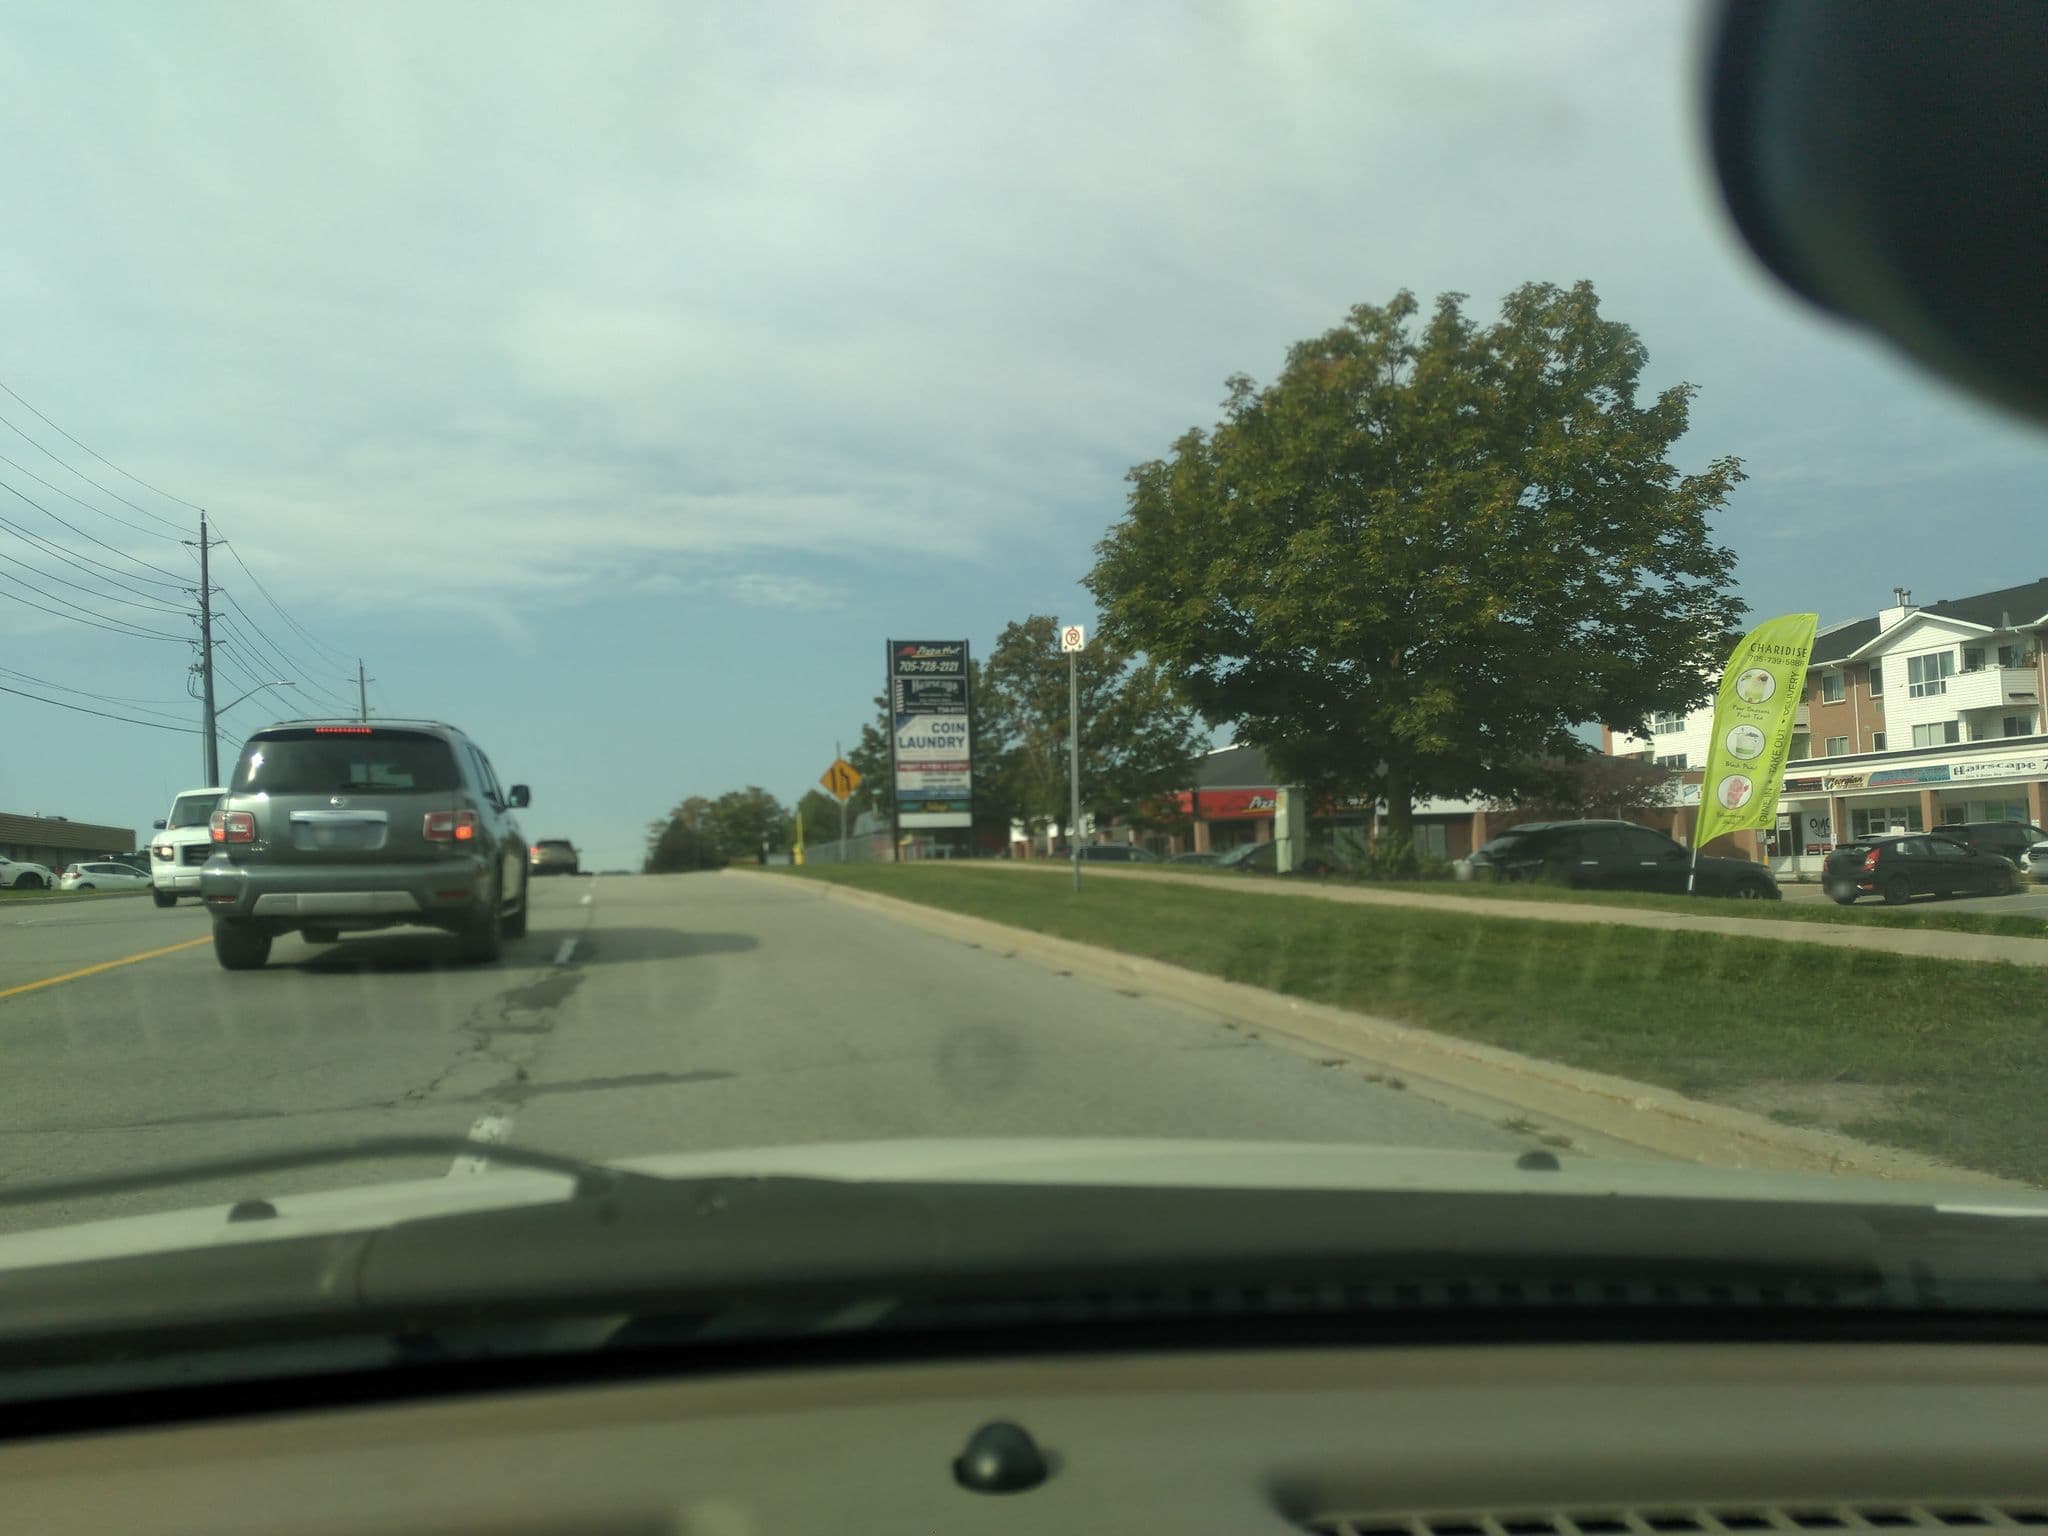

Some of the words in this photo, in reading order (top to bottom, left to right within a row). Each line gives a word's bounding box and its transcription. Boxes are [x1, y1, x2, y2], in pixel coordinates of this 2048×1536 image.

[1750, 642, 1808, 658] CHARIDISE
[931, 722, 965, 734] COIN
[899, 736, 965, 749] LAUNDRY
[1953, 761, 2036, 775] Hairscape
[1759, 798, 1772, 822] DINE
[1768, 749, 1781, 775] TAKE
